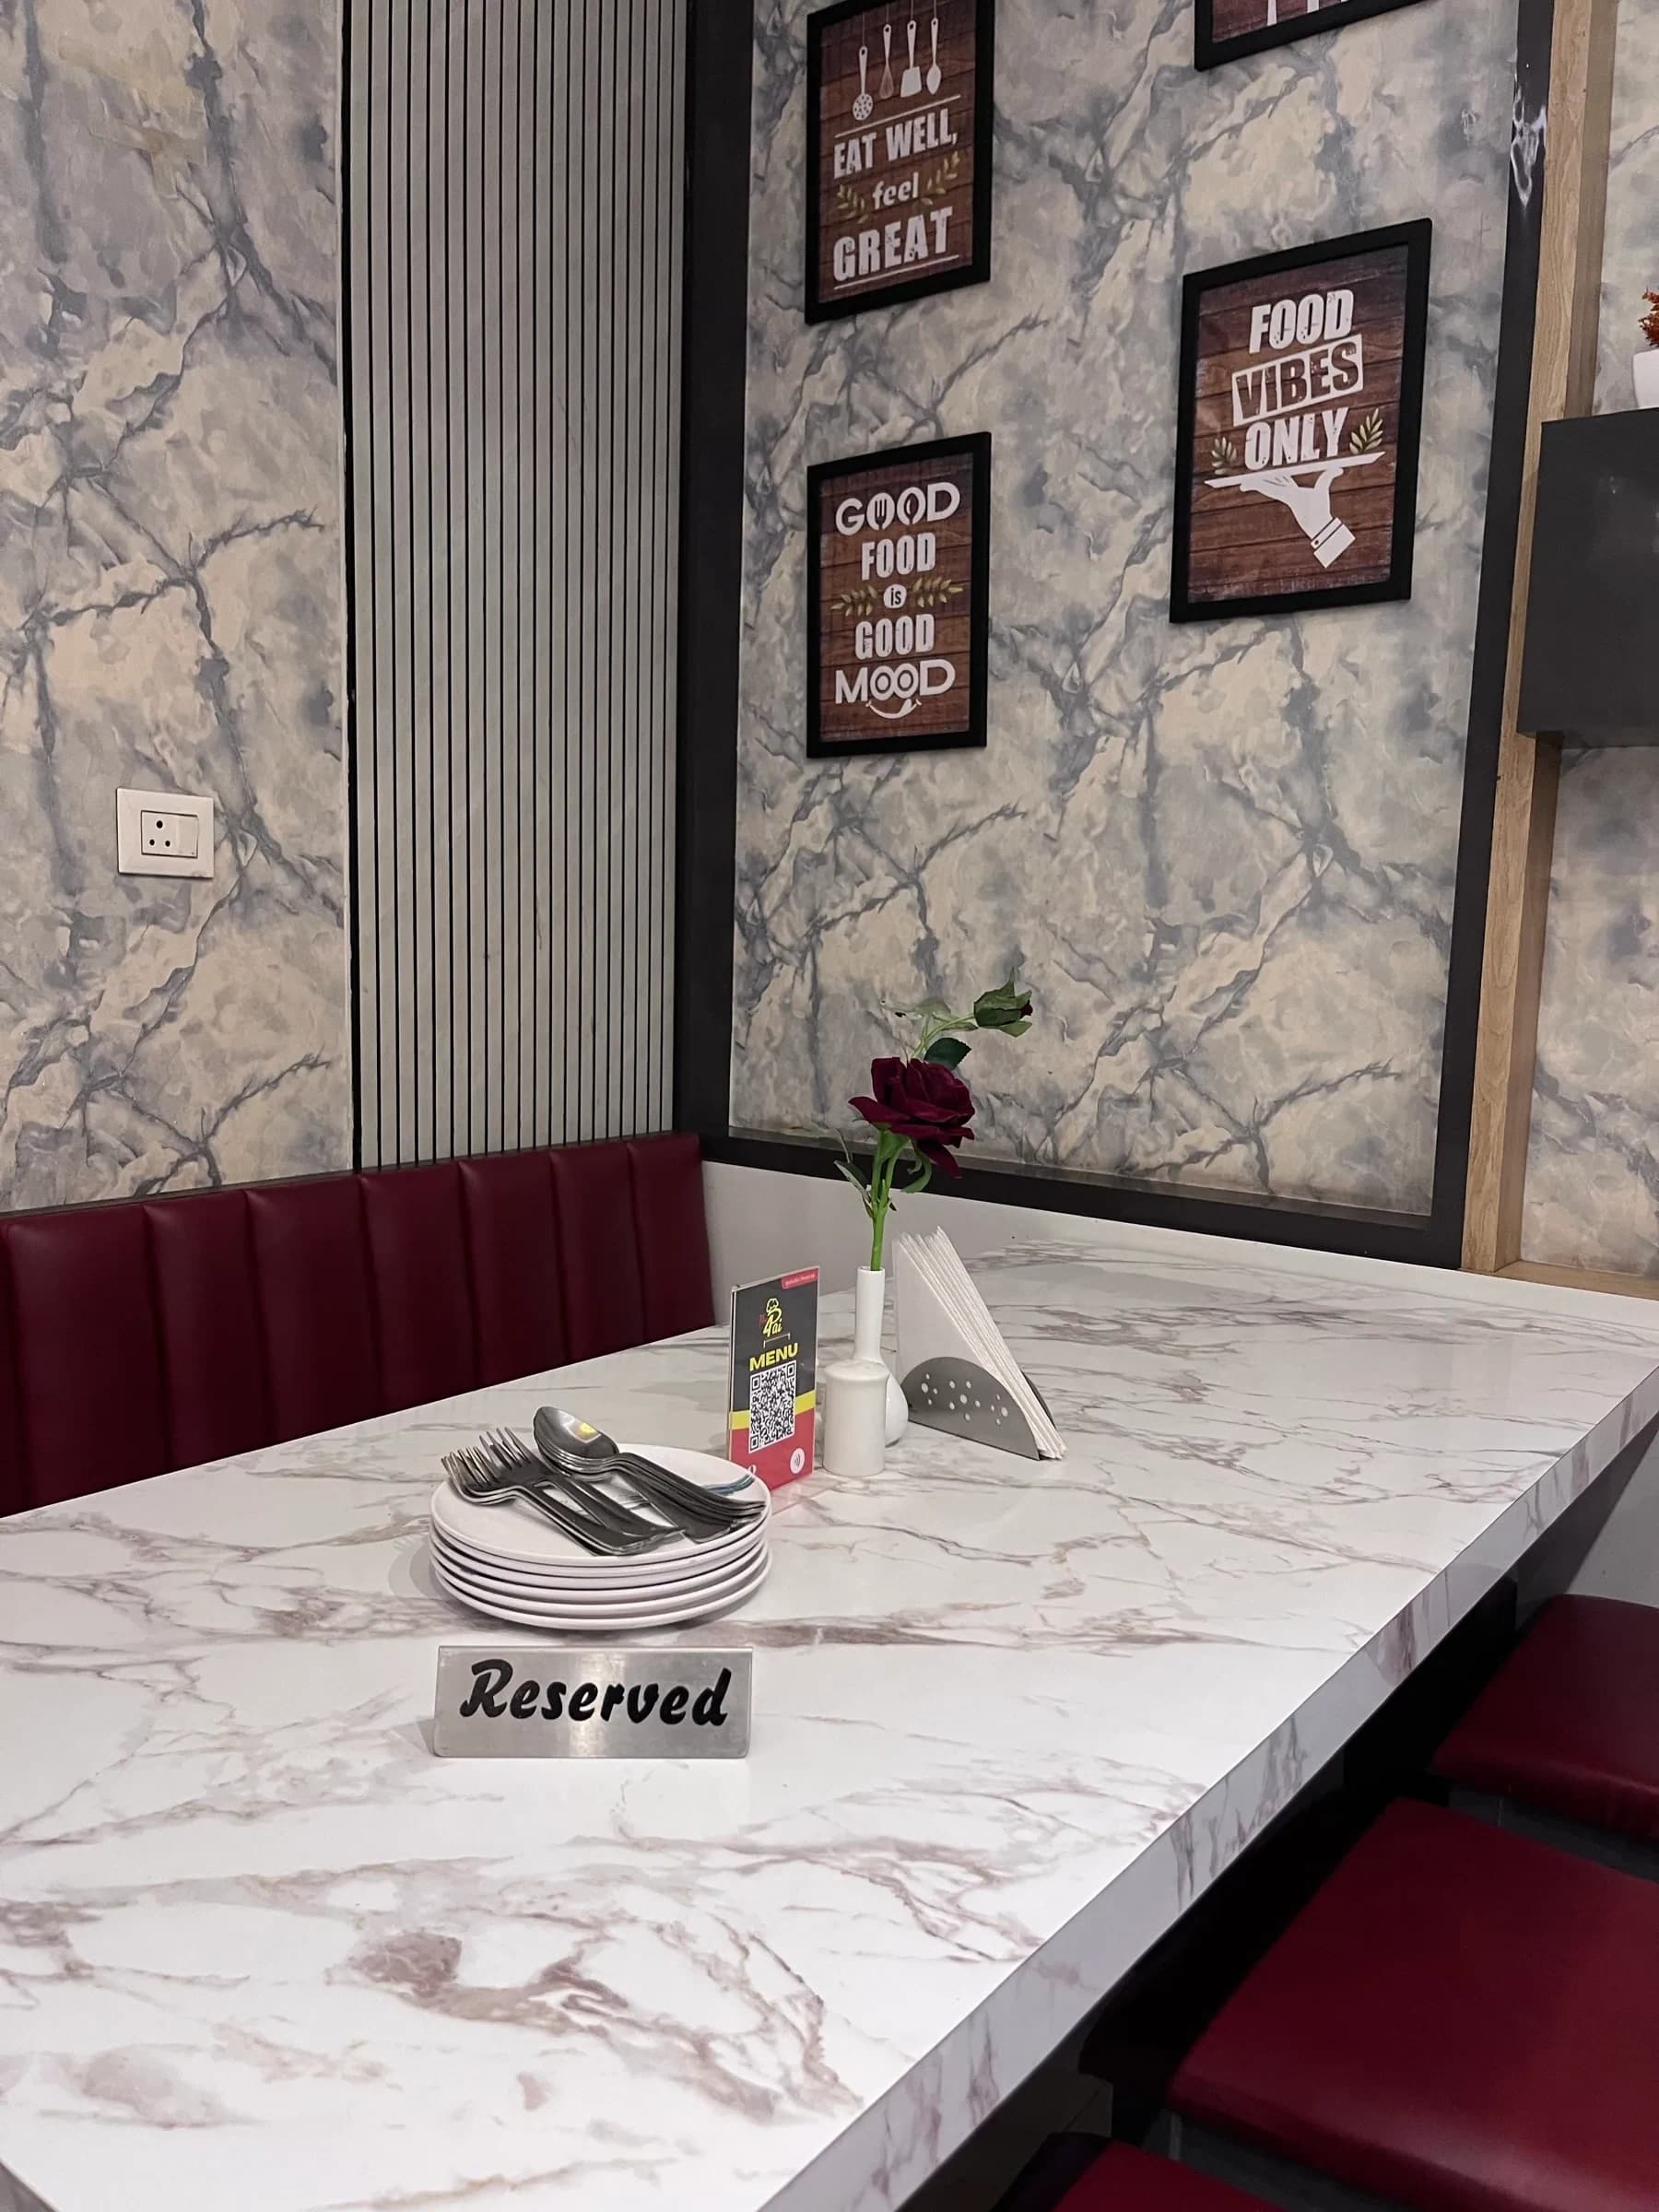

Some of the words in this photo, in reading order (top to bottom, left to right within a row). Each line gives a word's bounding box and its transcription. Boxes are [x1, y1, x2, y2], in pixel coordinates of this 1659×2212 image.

[833, 133, 877, 180] EAT
[886, 109, 958, 161] WELL,
[872, 171, 920, 209] feel
[833, 206, 953, 281] GREAT
[1249, 288, 1354, 354] FOOD
[1235, 340, 1360, 422] VIBES
[1244, 406, 1348, 472] ONLY
[835, 481, 960, 536] GOOD
[861, 532, 936, 581] FOOD
[889, 587, 902, 606] is
[855, 613, 935, 660] GOOD
[835, 658, 956, 704] MOOD
[749, 1343, 799, 1371] MENU
[459, 1658, 733, 1726] Reserved
